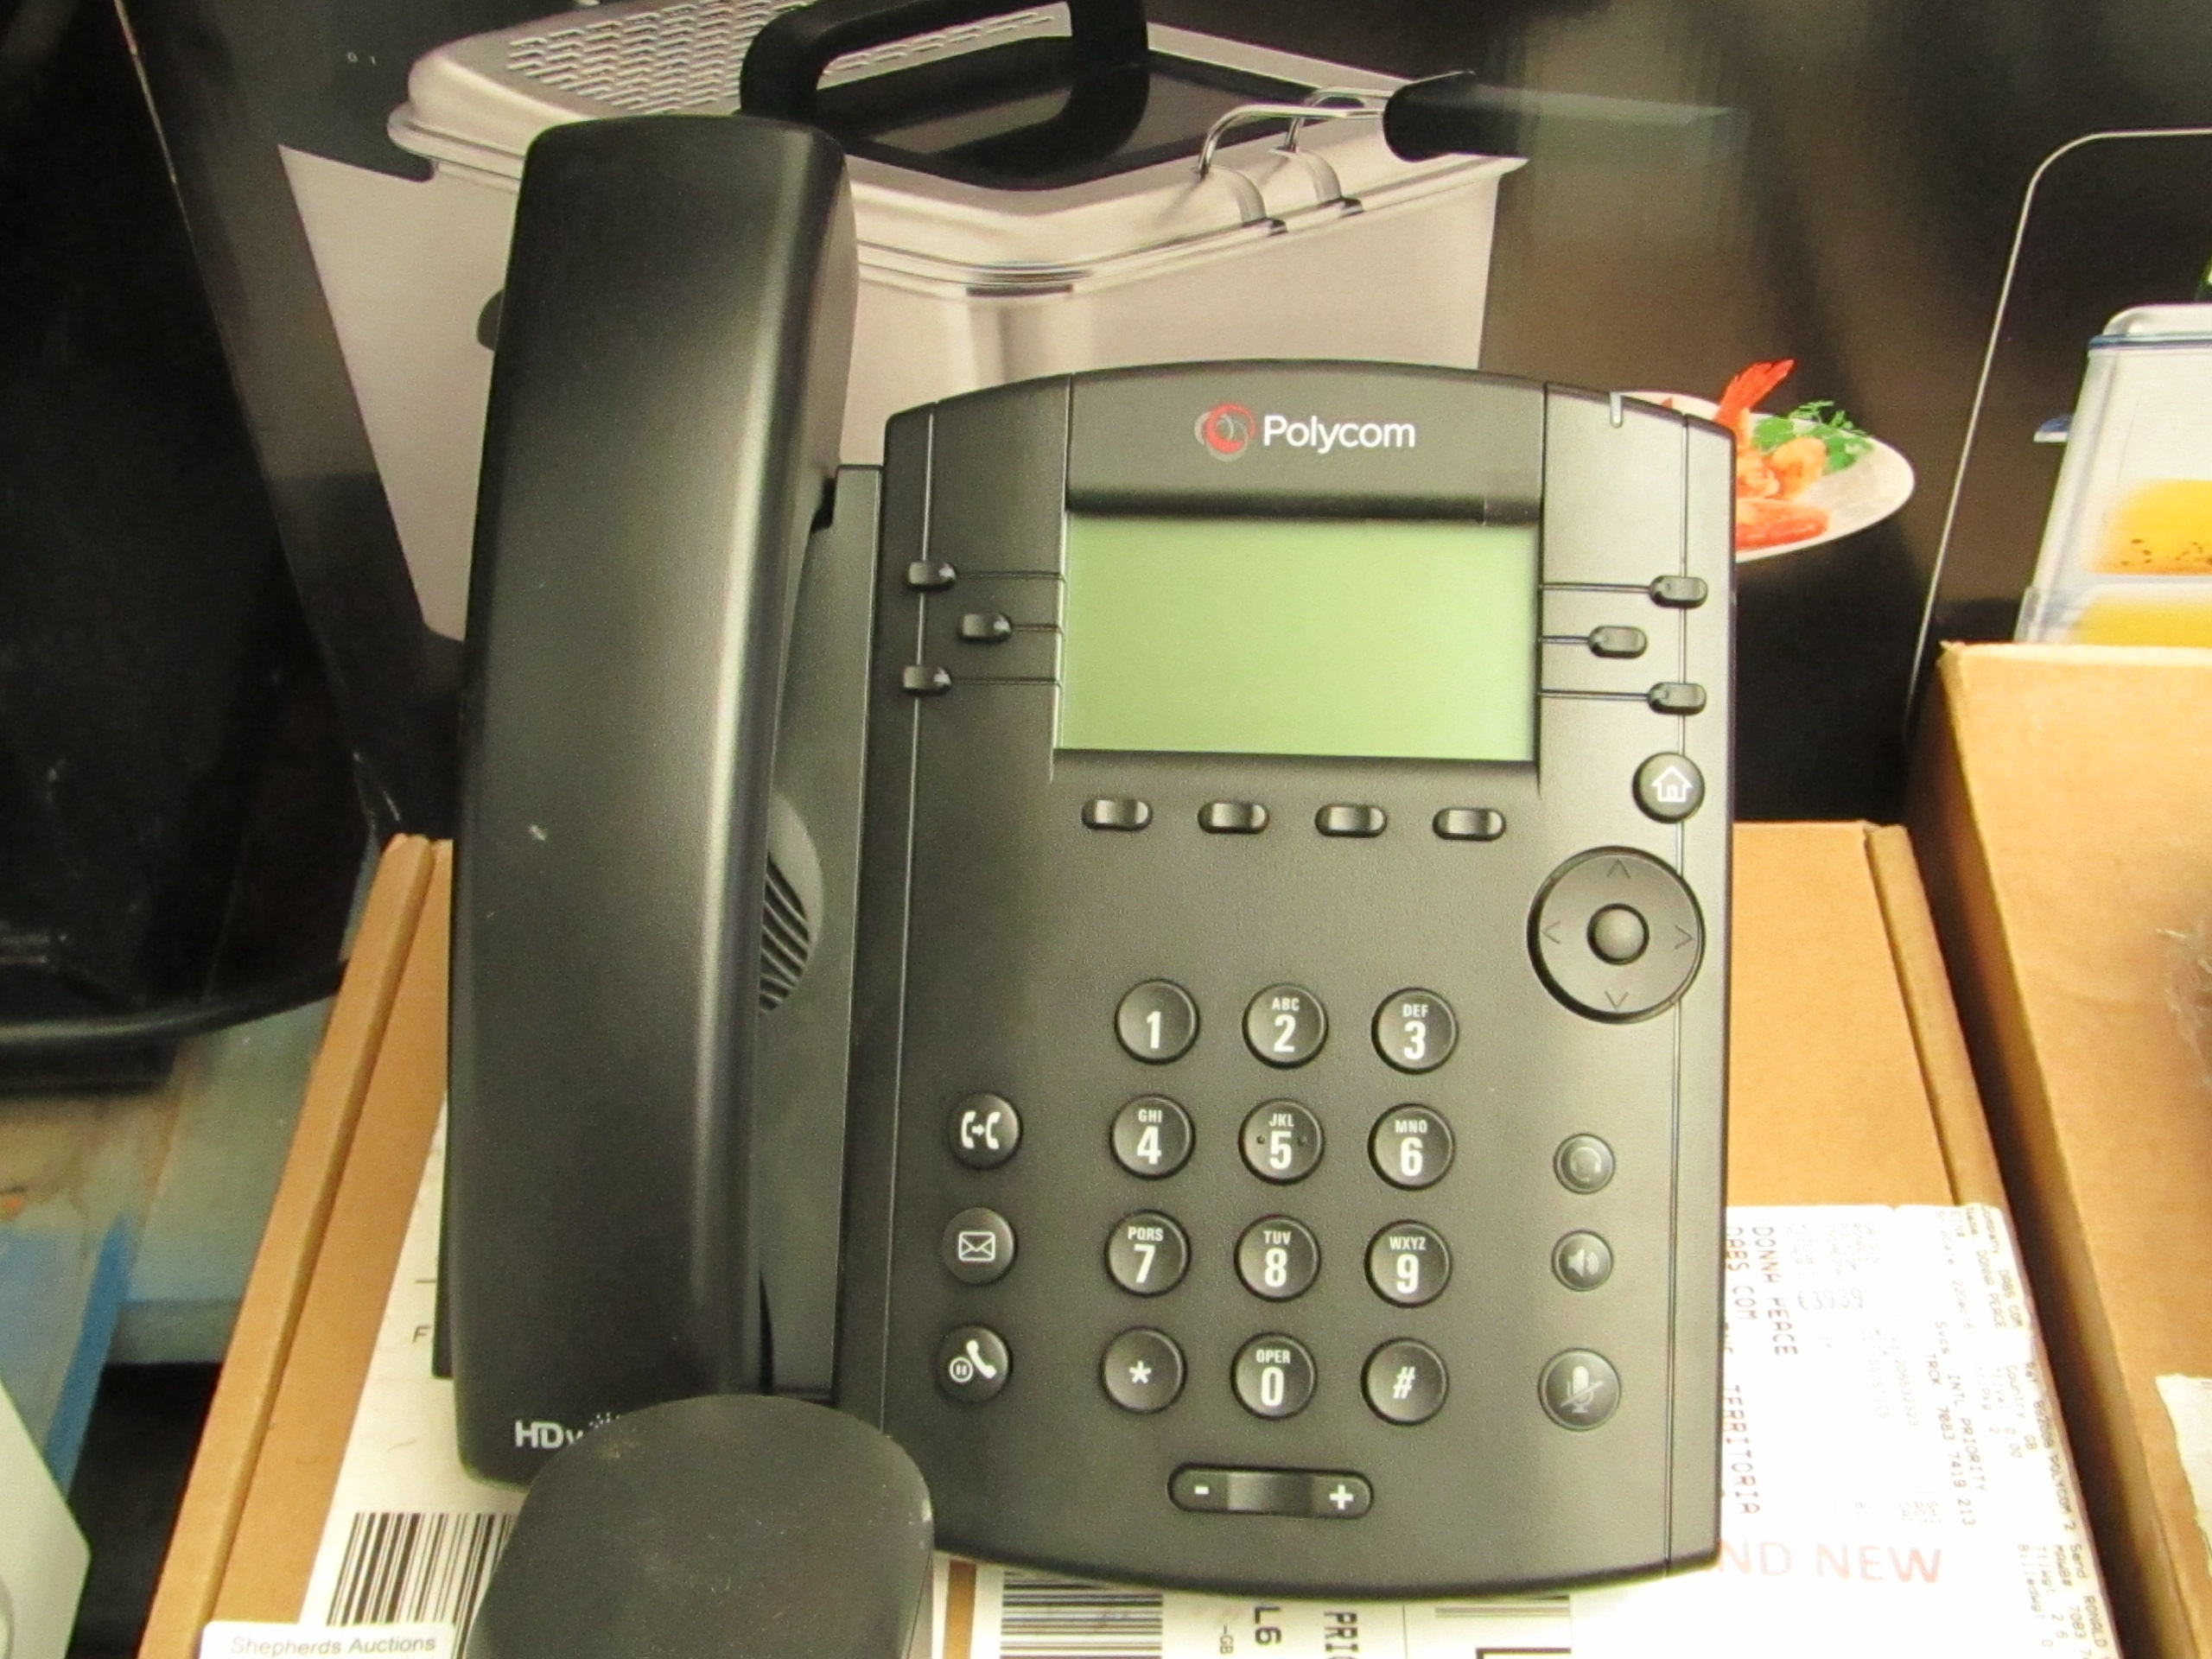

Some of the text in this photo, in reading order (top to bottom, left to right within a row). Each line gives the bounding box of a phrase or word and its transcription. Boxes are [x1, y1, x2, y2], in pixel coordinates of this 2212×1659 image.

[1263, 415, 1416, 454] Polycom
[1271, 997, 1300, 1011] ABC
[1402, 1003, 1428, 1018] DEF
[1147, 1011, 1160, 1049] 1
[1273, 1014, 1296, 1052] 2
[1403, 1020, 1426, 1060] 3
[1138, 1109, 1162, 1123] GHI
[1268, 1113, 1294, 1128] JKL
[1395, 1119, 1427, 1134] MNO
[1136, 1126, 1162, 1165] 4
[1268, 1130, 1292, 1170] 5
[1400, 1137, 1423, 1177] 6
[1128, 1226, 1163, 1242] PQRS
[1263, 1230, 1291, 1245] TUV
[1389, 1236, 1426, 1250] WXYZ
[1134, 1243, 1155, 1283] 7
[1264, 1248, 1287, 1287] 8
[1396, 1254, 1419, 1294] 9
[1752, 1227, 1782, 1283] DONNA
[1767, 1298, 1798, 1355] PEACE
[1989, 1293, 2007, 1329] PEACE
[1255, 1349, 1291, 1363] OPER
[1261, 1366, 1284, 1407] 0
[1948, 1375, 1967, 1407] INTL
[1960, 1418, 1987, 1491] PRIORITY
[2024, 1434, 2038, 1450] GB
[1937, 1407, 1956, 1440] 7083
[1948, 1452, 1967, 1488] 7419
[1958, 1498, 1977, 1526] 213
[1815, 1542, 1942, 1584] NEW
[1324, 1611, 1359, 1659] PRI
[2069, 1605, 2088, 1638] 7083
[2083, 1595, 2108, 1649] RONALD
[231, 1635, 436, 1657] Shepherds Auctions
